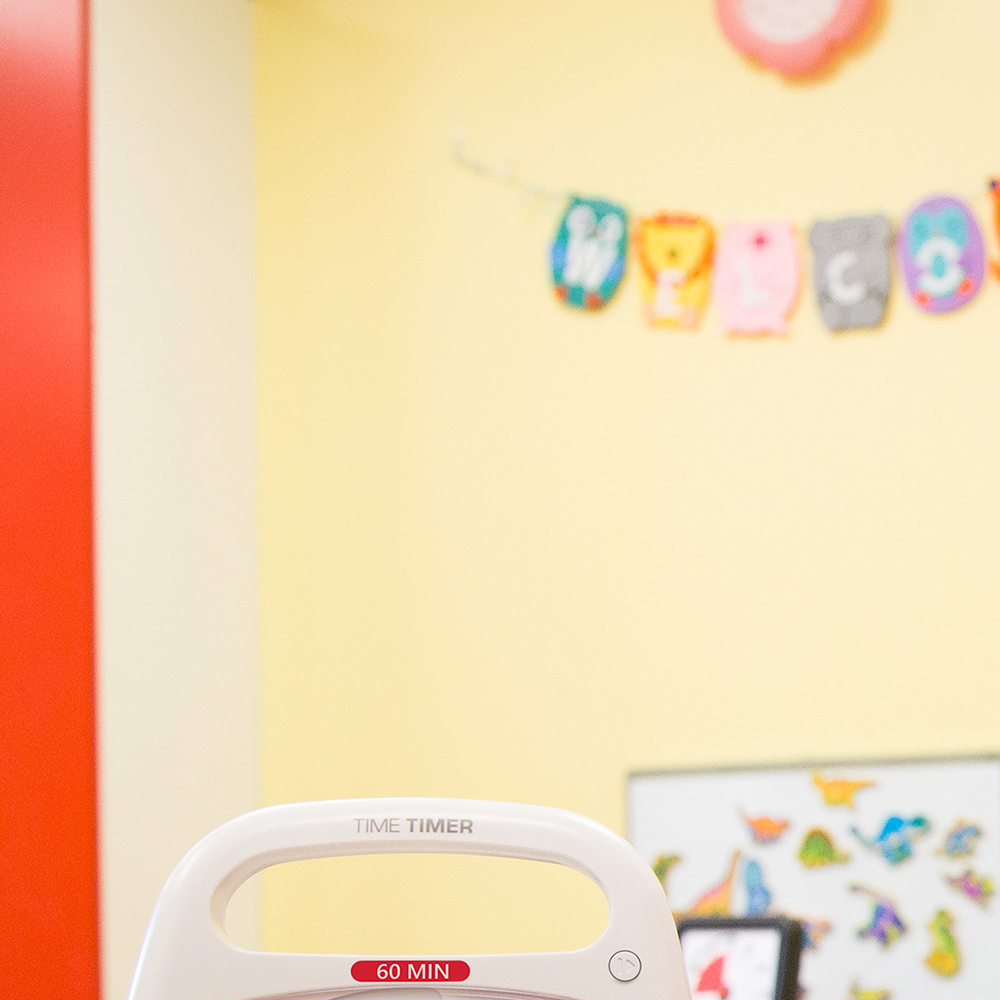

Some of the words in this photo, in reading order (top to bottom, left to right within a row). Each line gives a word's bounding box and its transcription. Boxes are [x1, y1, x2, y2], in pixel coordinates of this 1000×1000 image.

[355, 818, 400, 833] TIME
[407, 818, 474, 834] TIMER
[376, 963, 401, 980] 60
[407, 963, 450, 979] MIN
